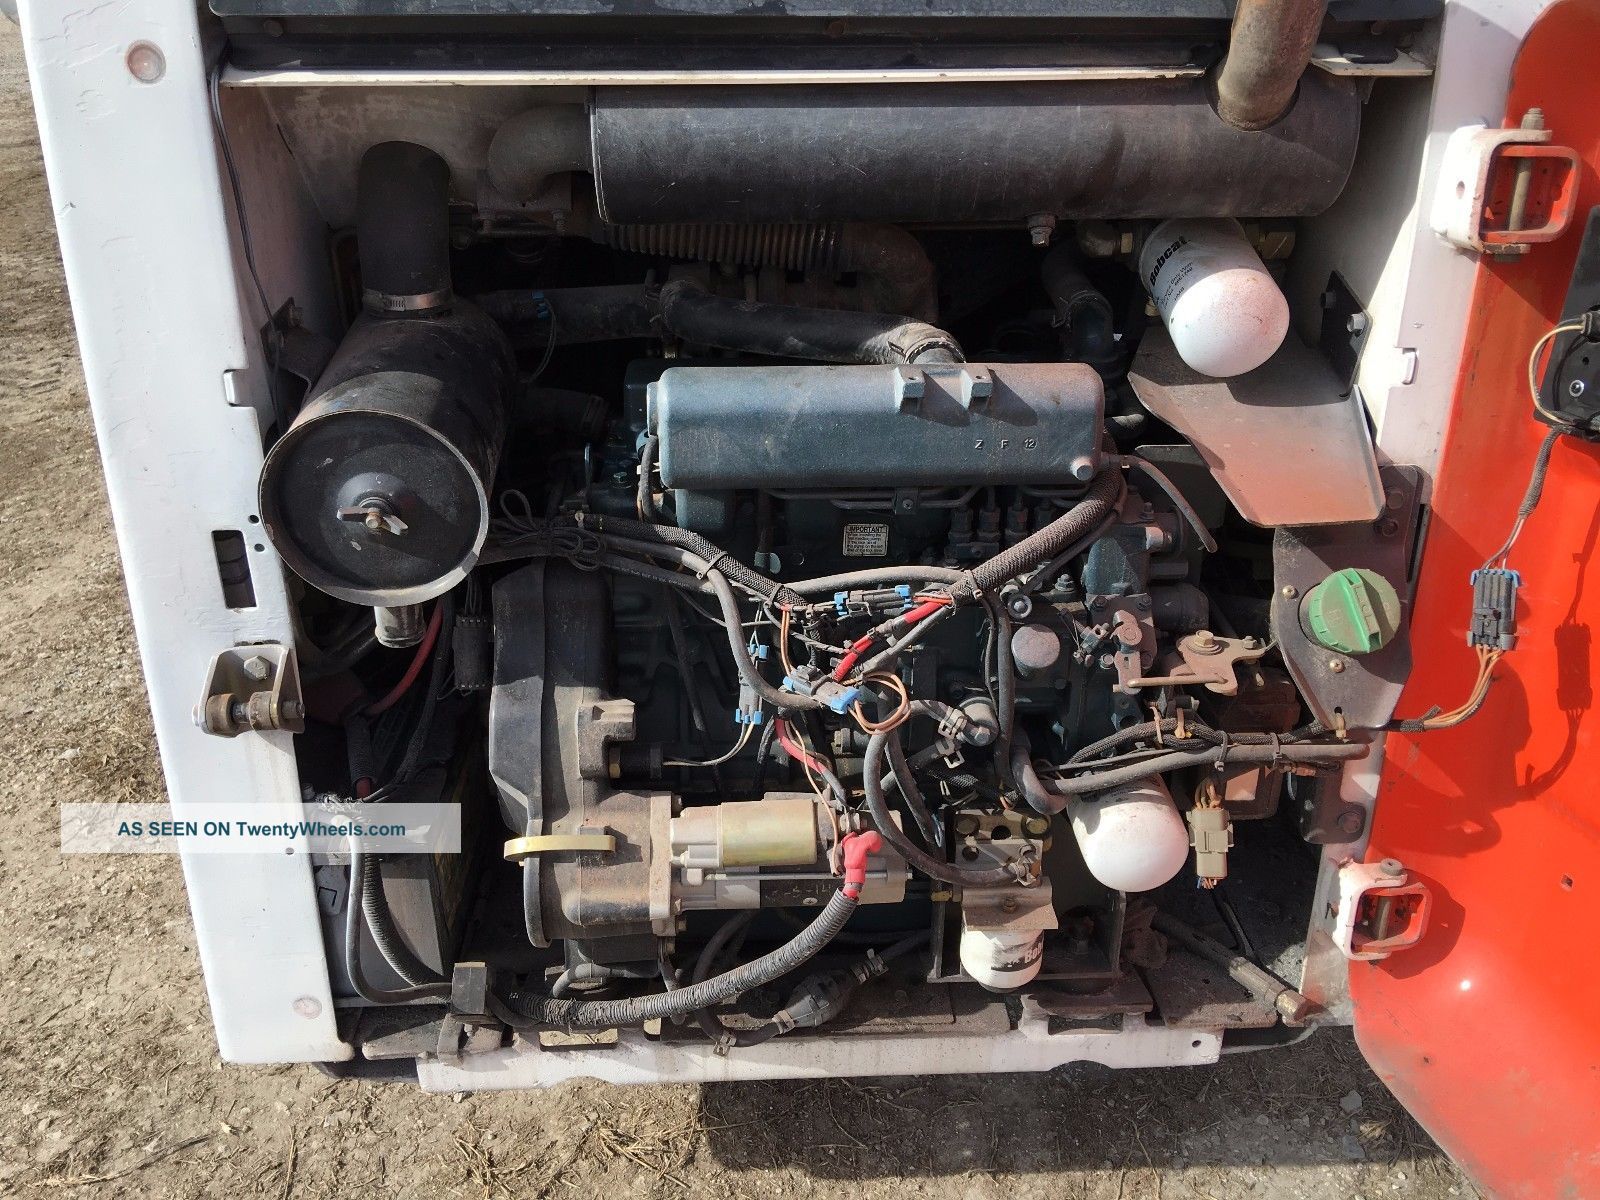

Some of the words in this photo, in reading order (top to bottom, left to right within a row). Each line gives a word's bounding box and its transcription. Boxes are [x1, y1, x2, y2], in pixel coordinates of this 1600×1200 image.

[1149, 236, 1189, 287] Bobcat
[974, 439, 984, 449] Z
[1000, 439, 1009, 449] F
